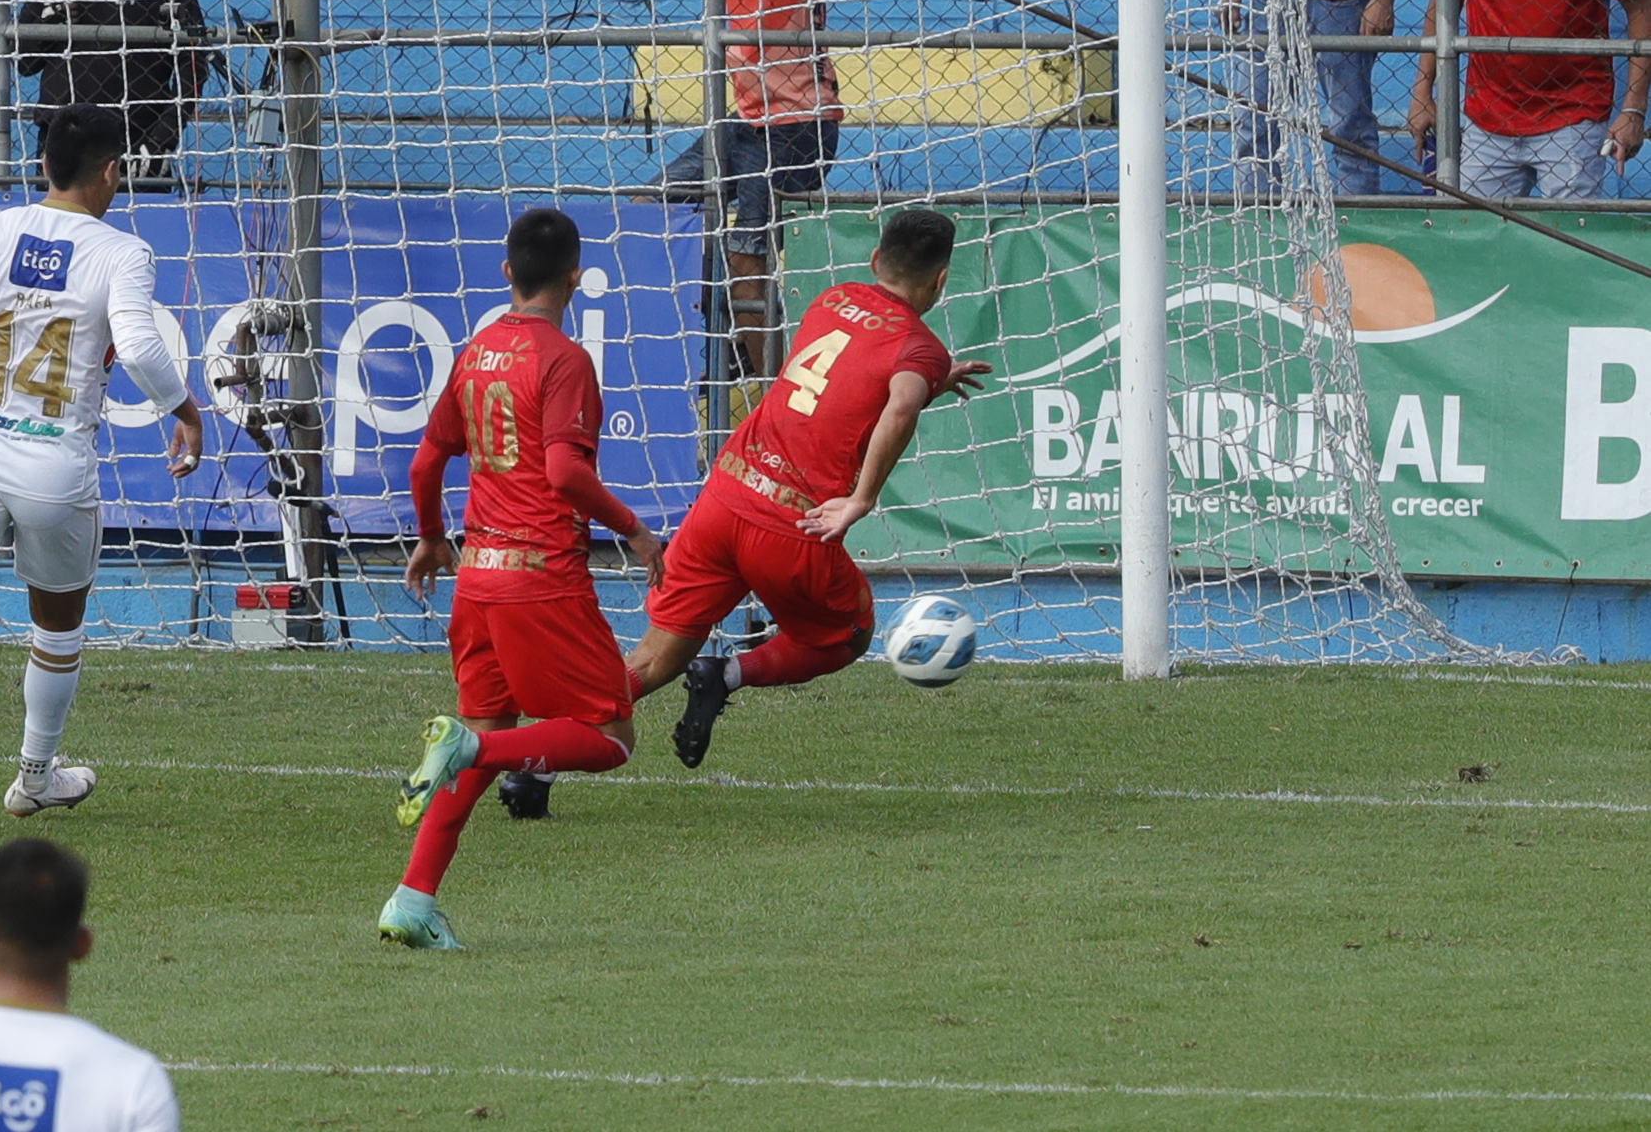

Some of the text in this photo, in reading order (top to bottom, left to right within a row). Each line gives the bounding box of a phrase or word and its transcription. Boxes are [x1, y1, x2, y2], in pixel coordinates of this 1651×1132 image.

[821, 289, 884, 331] Claro
[463, 343, 514, 372] Claro
[783, 329, 852, 417] 4
[463, 379, 520, 474] 10
[1033, 487, 1057, 511] El
[1067, 488, 1120, 511] ami
[1391, 494, 1484, 517] crecer
